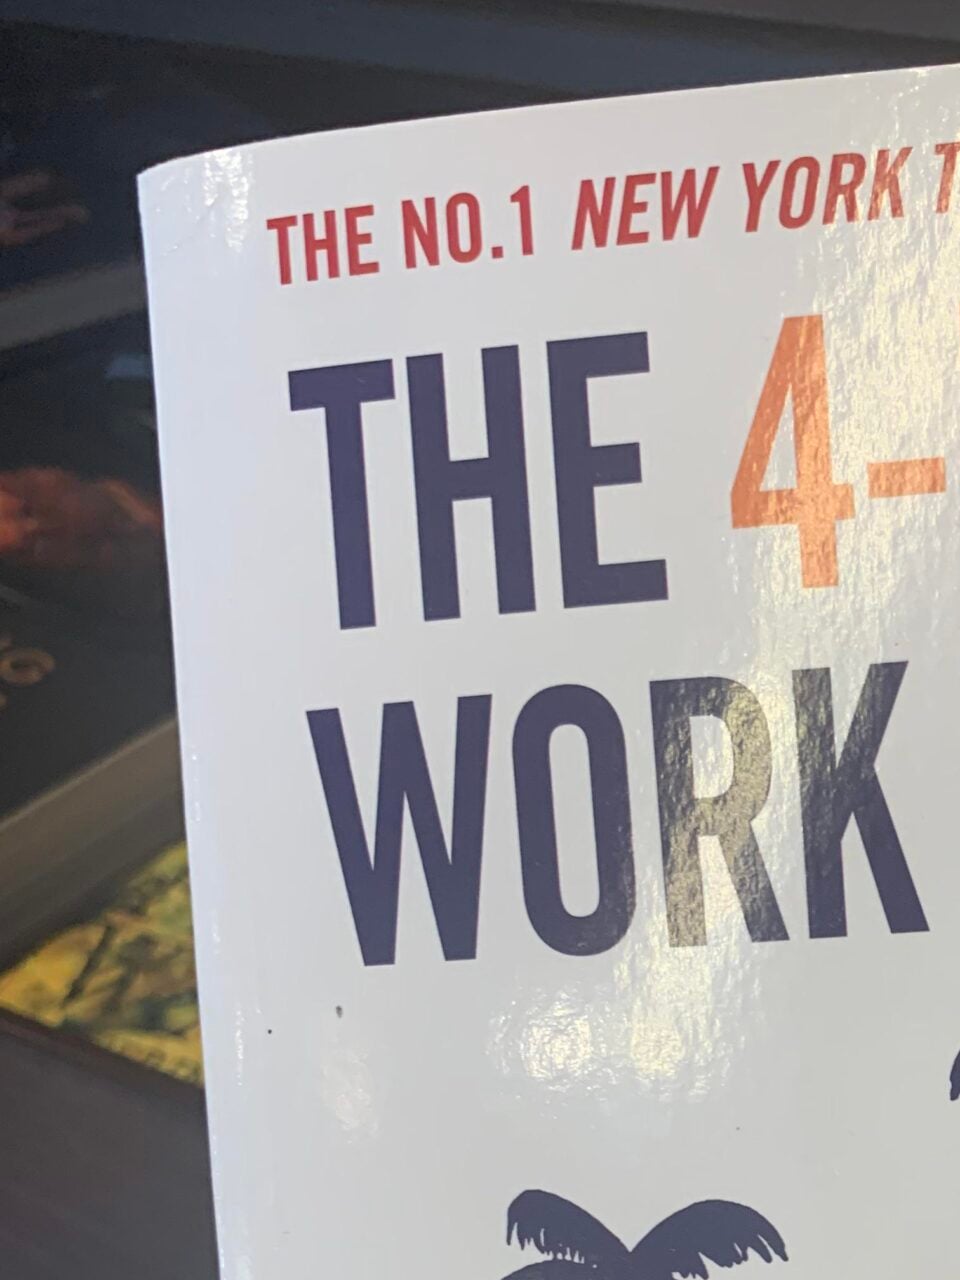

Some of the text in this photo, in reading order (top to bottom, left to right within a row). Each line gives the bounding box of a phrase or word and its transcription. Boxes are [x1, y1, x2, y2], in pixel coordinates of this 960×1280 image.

[266, 204, 380, 286] THE
[401, 185, 536, 270] NO.1
[570, 165, 720, 251] NEW
[741, 146, 913, 233] YORK
[288, 331, 669, 630] THE
[305, 660, 931, 967] WORK
